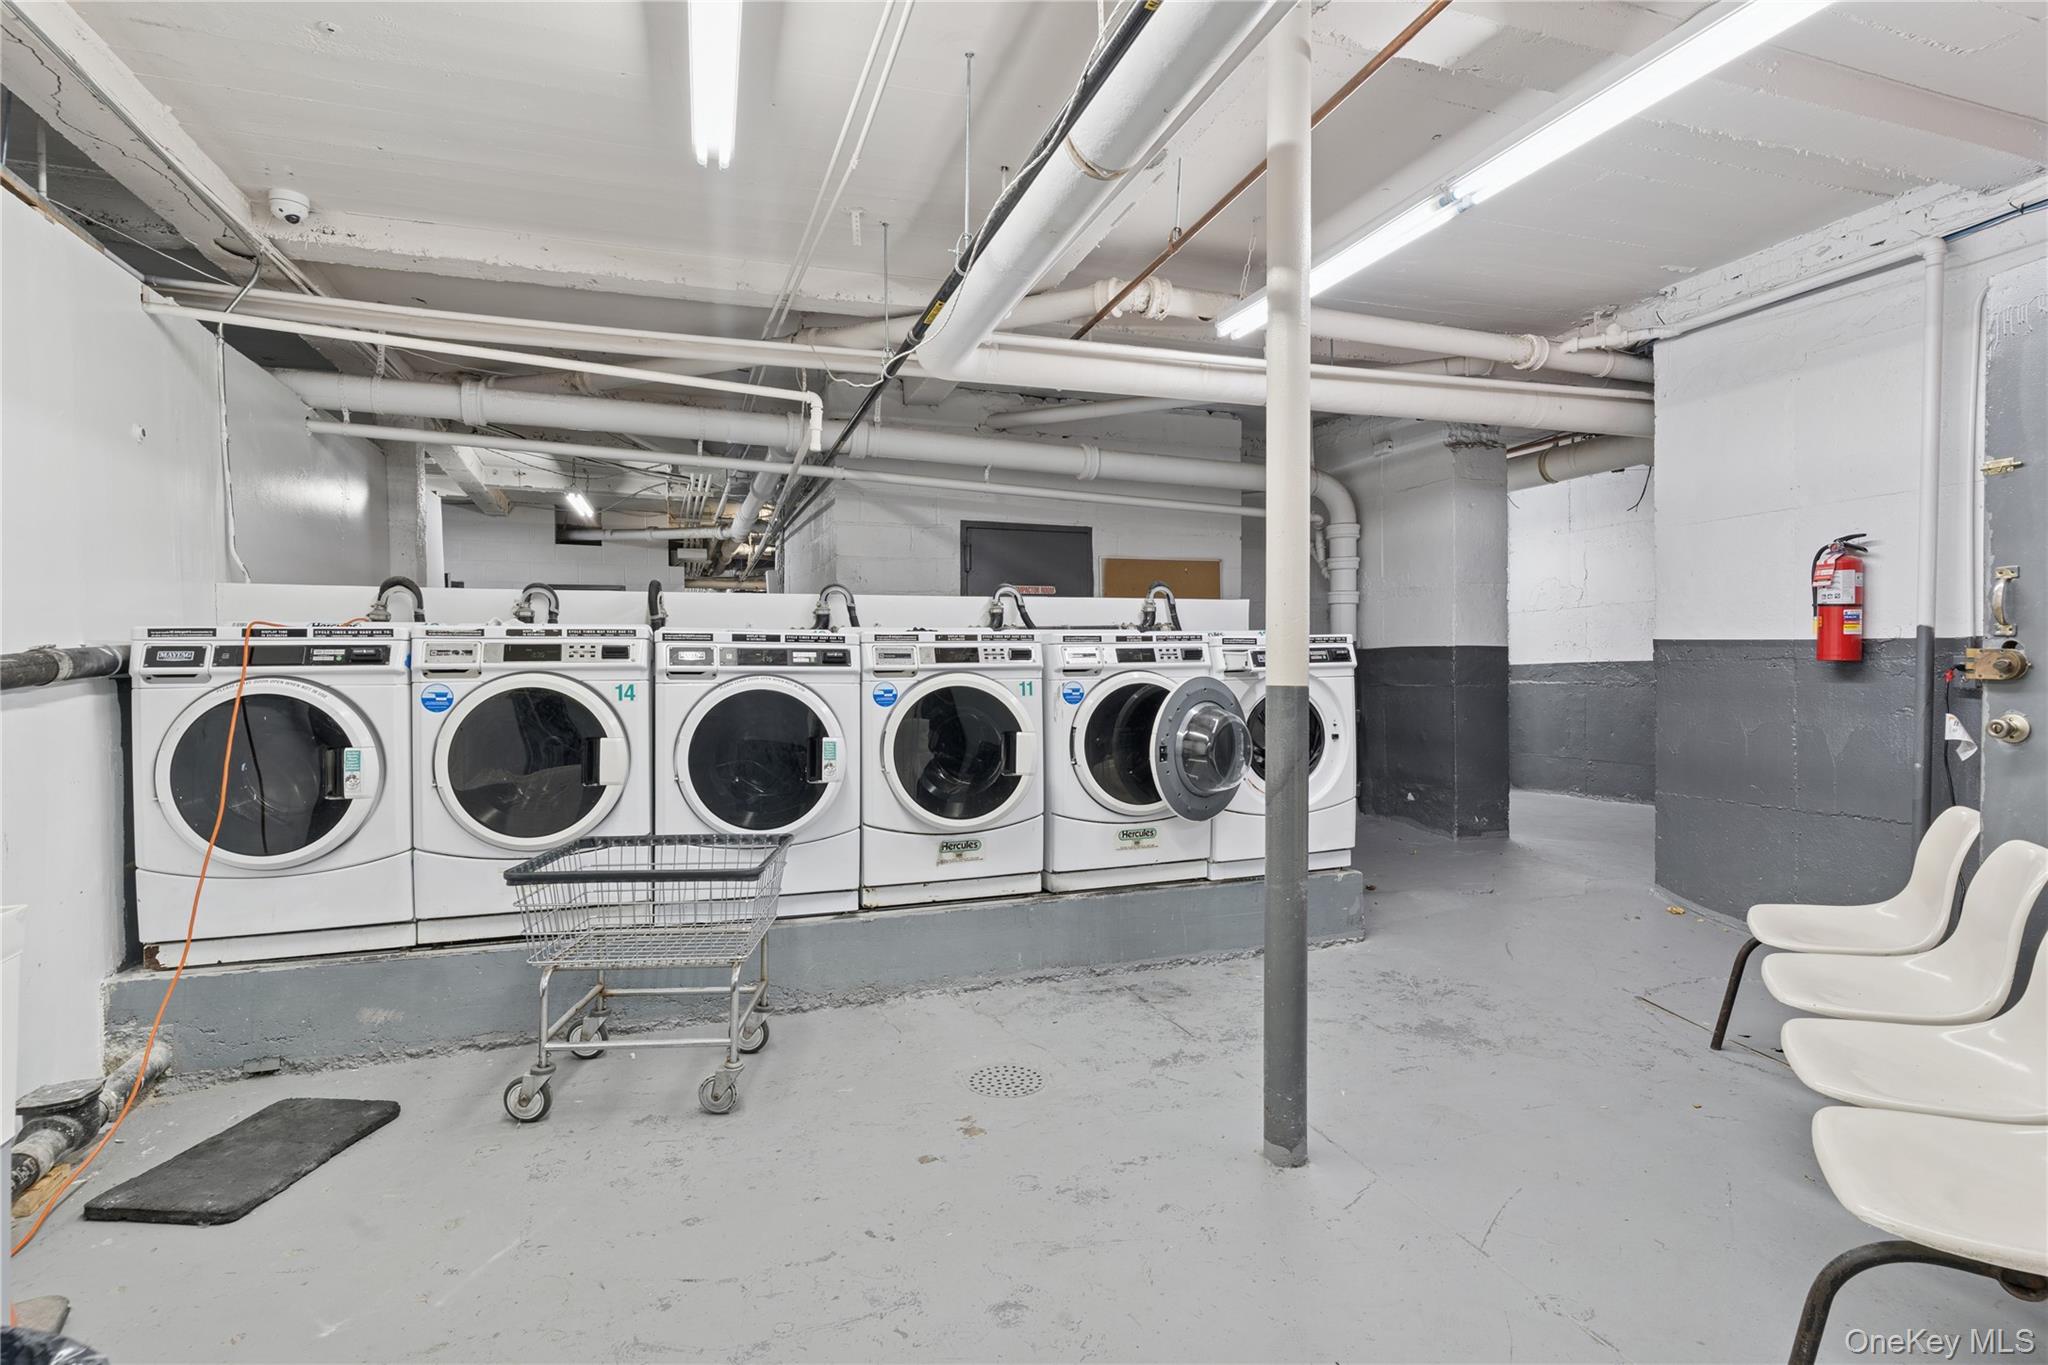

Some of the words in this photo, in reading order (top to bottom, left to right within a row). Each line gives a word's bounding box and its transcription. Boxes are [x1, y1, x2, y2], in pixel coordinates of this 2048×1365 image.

[615, 684, 636, 701] 14
[1019, 681, 1033, 696] 11
[1121, 829, 1154, 838] Hercules
[941, 840, 978, 850] Hercules
